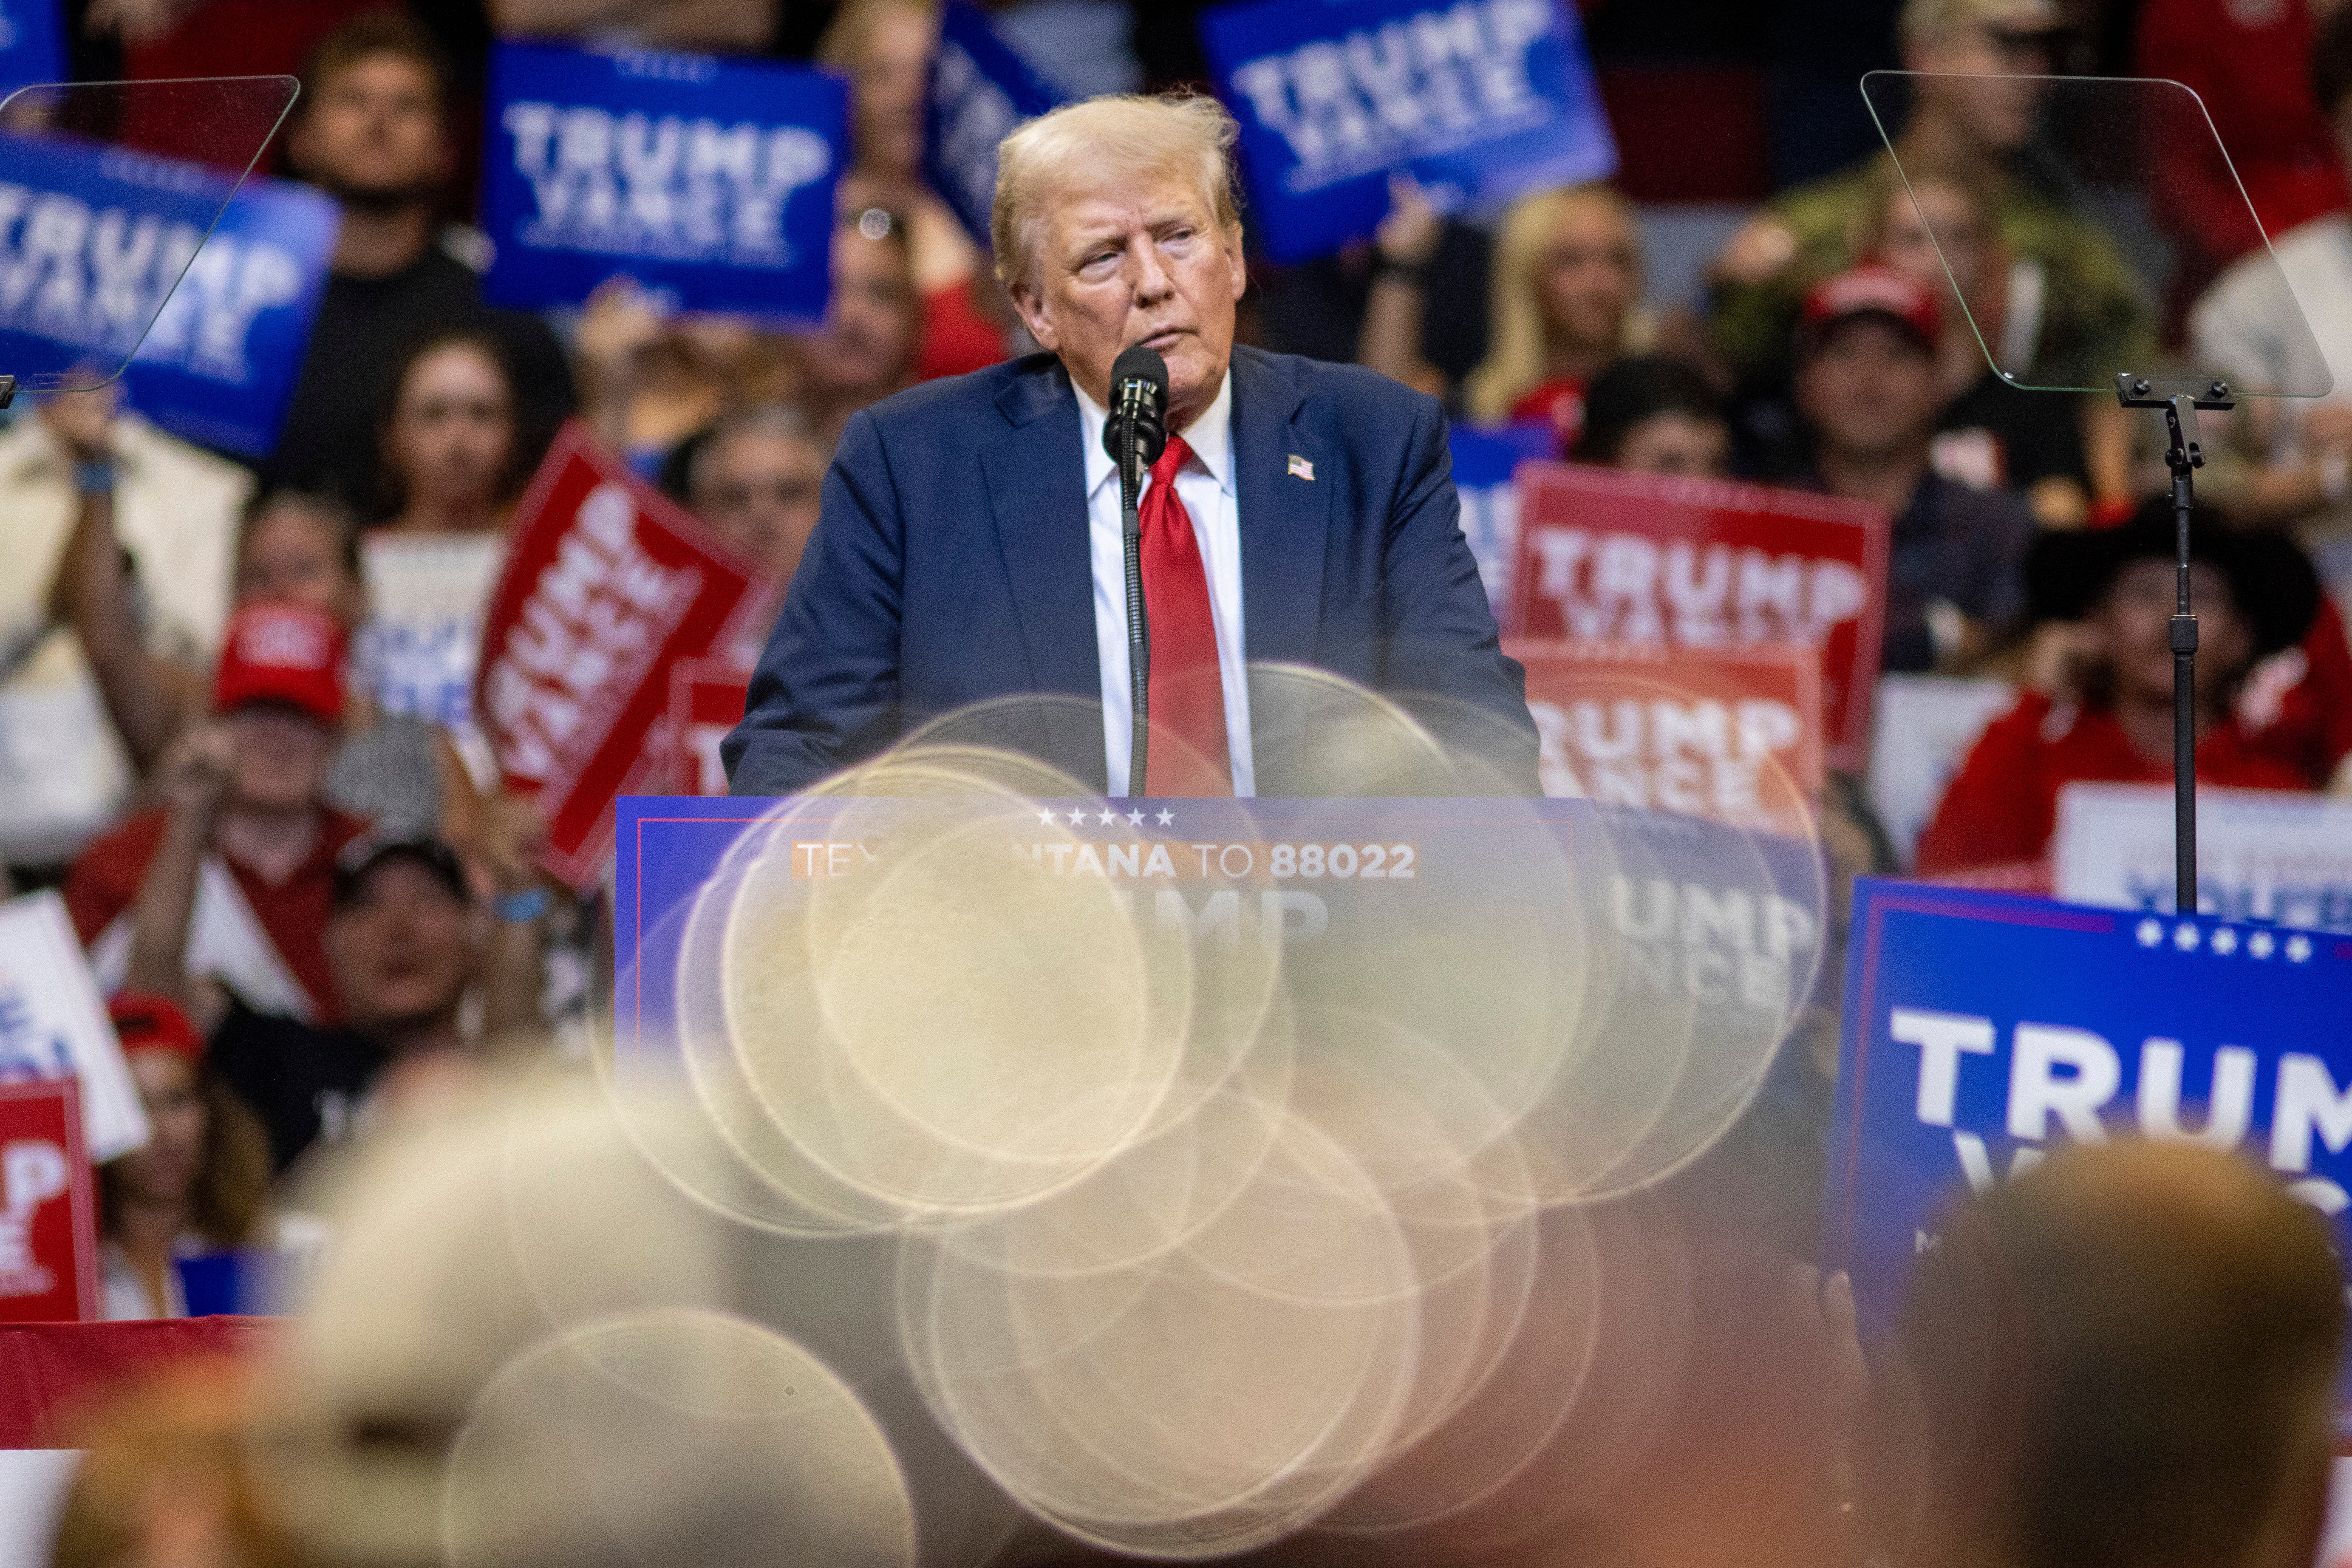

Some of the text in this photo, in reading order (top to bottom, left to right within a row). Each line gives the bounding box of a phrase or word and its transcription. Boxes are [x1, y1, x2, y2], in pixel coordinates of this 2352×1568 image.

[504, 101, 833, 187] TRUMP
[1532, 527, 1866, 628] TRUMP
[1529, 699, 1801, 761] RUMP
[797, 843, 1415, 878] TE NTANA TO 88022
[1612, 877, 1814, 959] UMP
[1626, 941, 1786, 1010] NCE
[1891, 1007, 2352, 1172] TRUM
